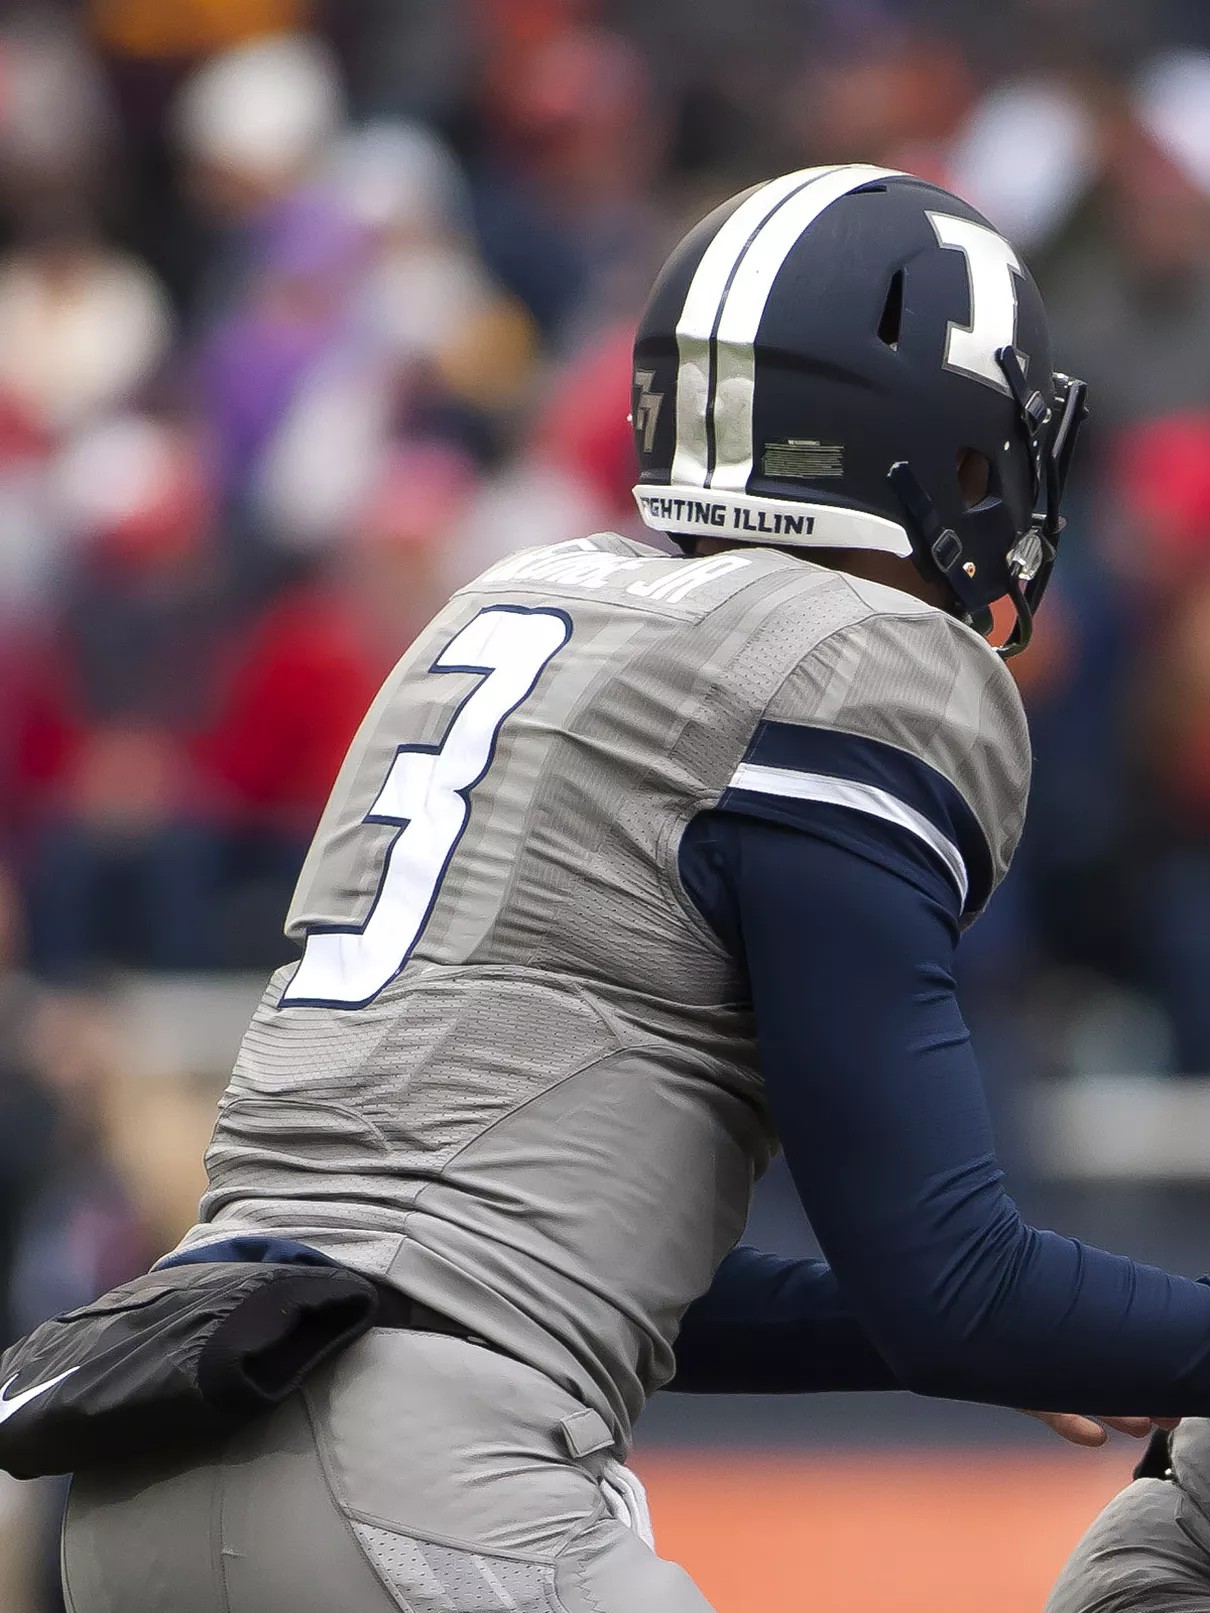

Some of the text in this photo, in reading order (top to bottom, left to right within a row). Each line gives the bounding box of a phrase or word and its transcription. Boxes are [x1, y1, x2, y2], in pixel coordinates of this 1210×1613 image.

[925, 210, 1030, 398] I
[640, 497, 815, 536] GHTING ILLINI
[278, 603, 573, 1011] 3
